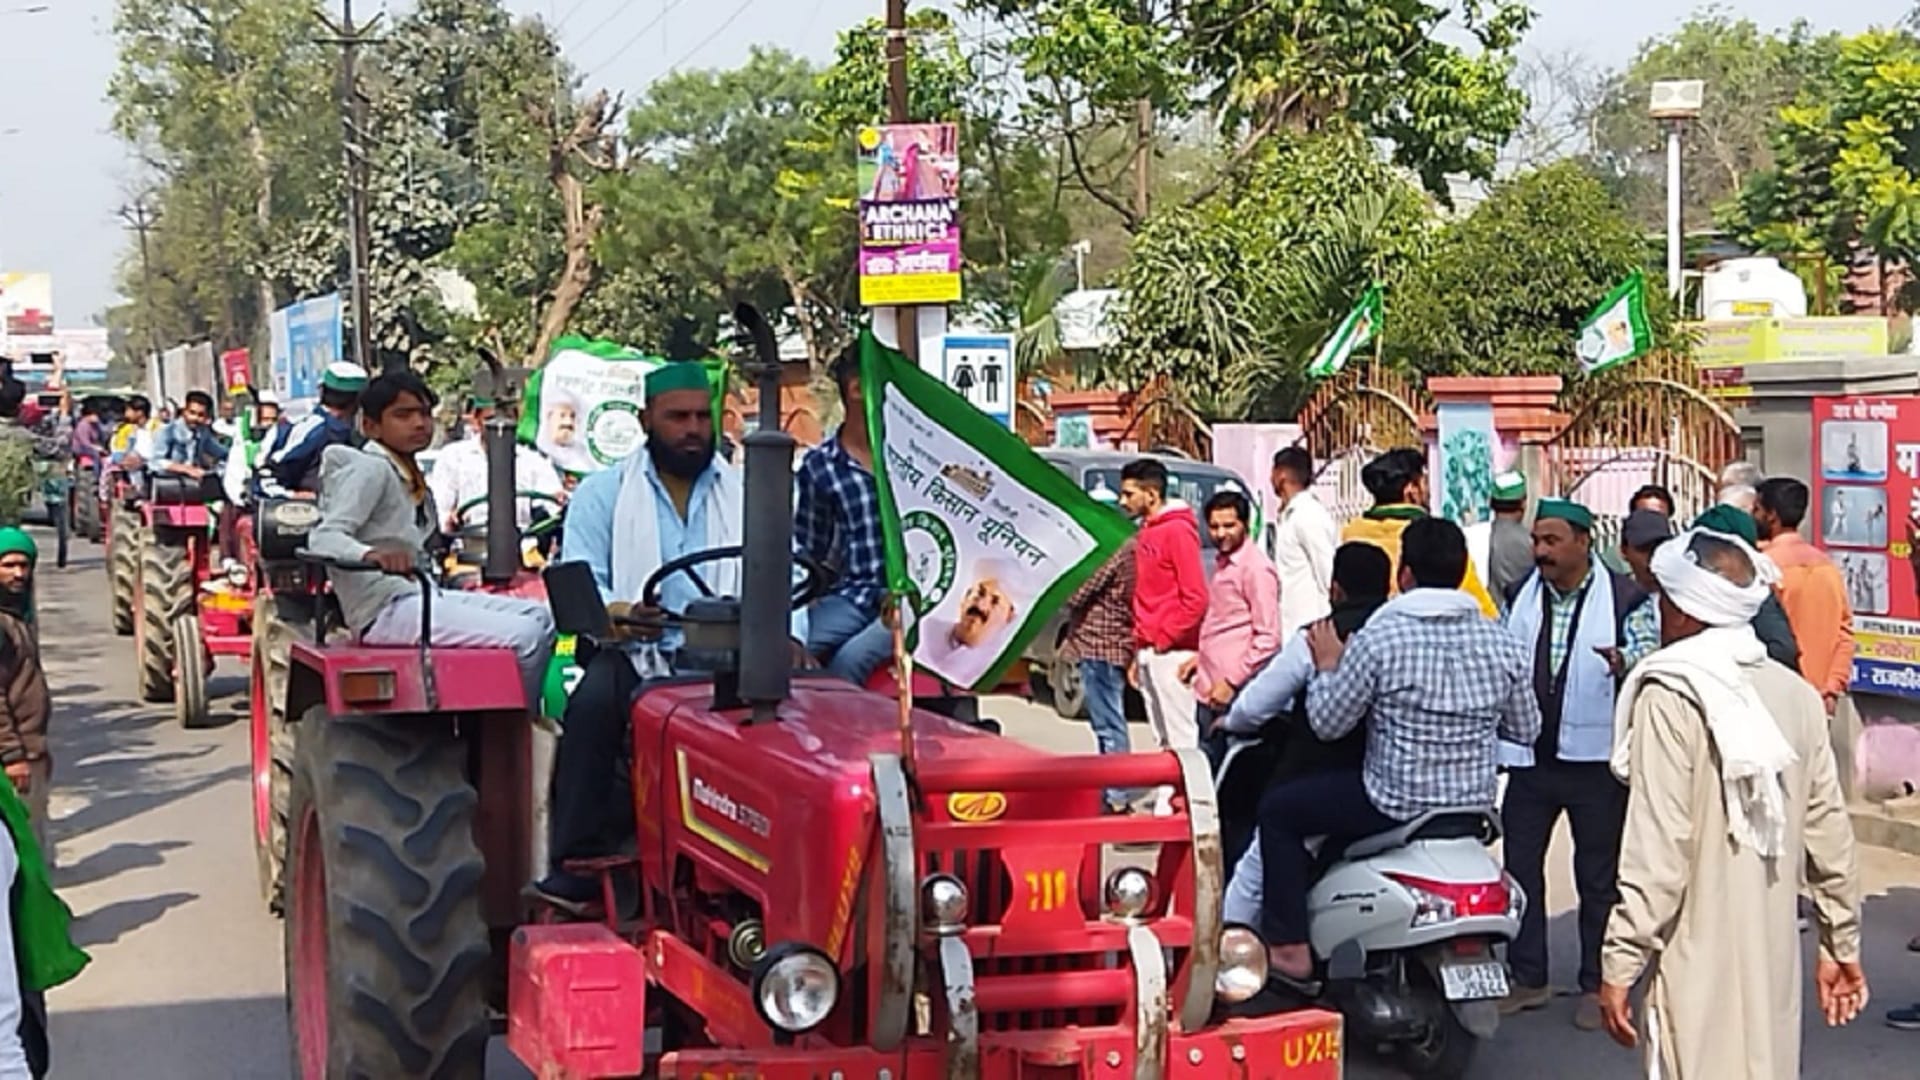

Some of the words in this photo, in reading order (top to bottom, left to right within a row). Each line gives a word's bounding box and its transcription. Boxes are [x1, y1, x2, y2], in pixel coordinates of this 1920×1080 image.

[866, 203, 953, 223] ARCHANA
[873, 223, 948, 240] ETHNICS
[922, 475, 980, 524] किसान
[977, 515, 1048, 567] यूनियन
